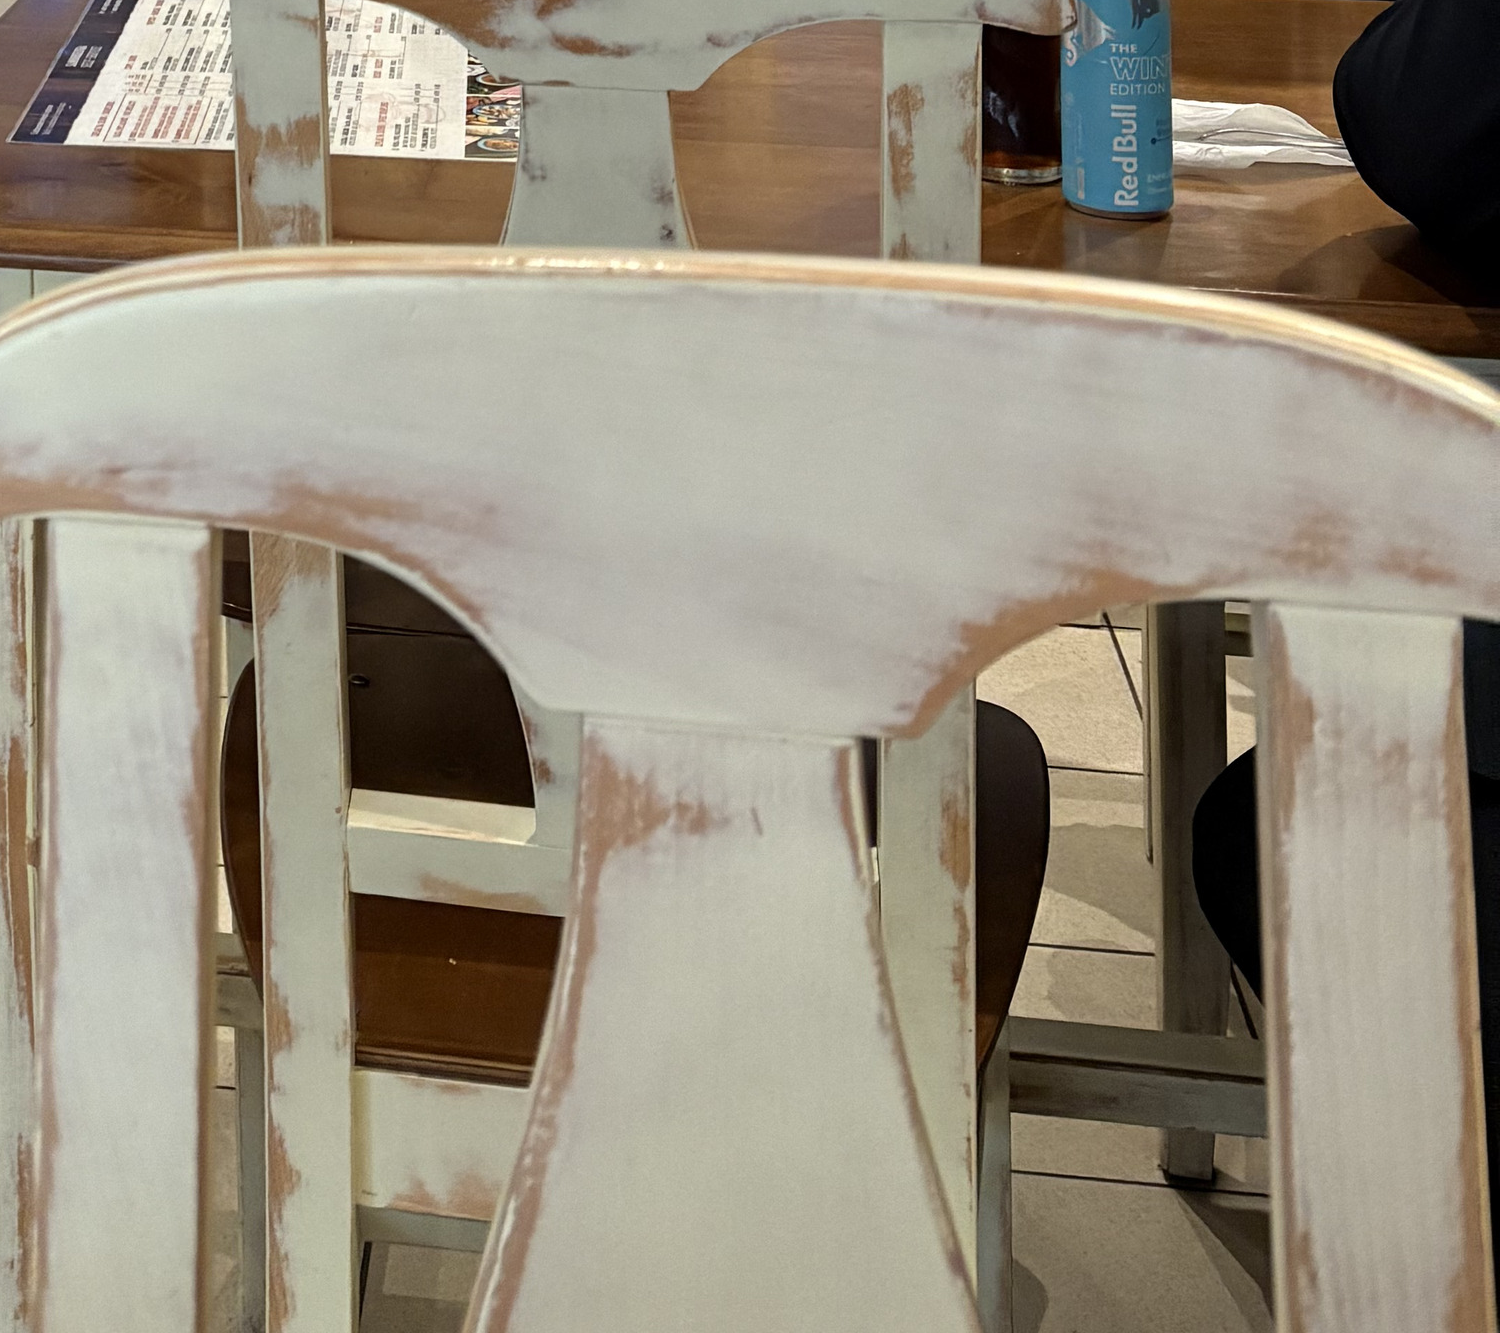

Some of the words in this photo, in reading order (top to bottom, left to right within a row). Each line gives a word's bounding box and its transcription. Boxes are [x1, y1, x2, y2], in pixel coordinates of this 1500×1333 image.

[1109, 43, 1138, 54] THE
[1109, 54, 1172, 81] WIN
[1109, 82, 1166, 96] EDITION
